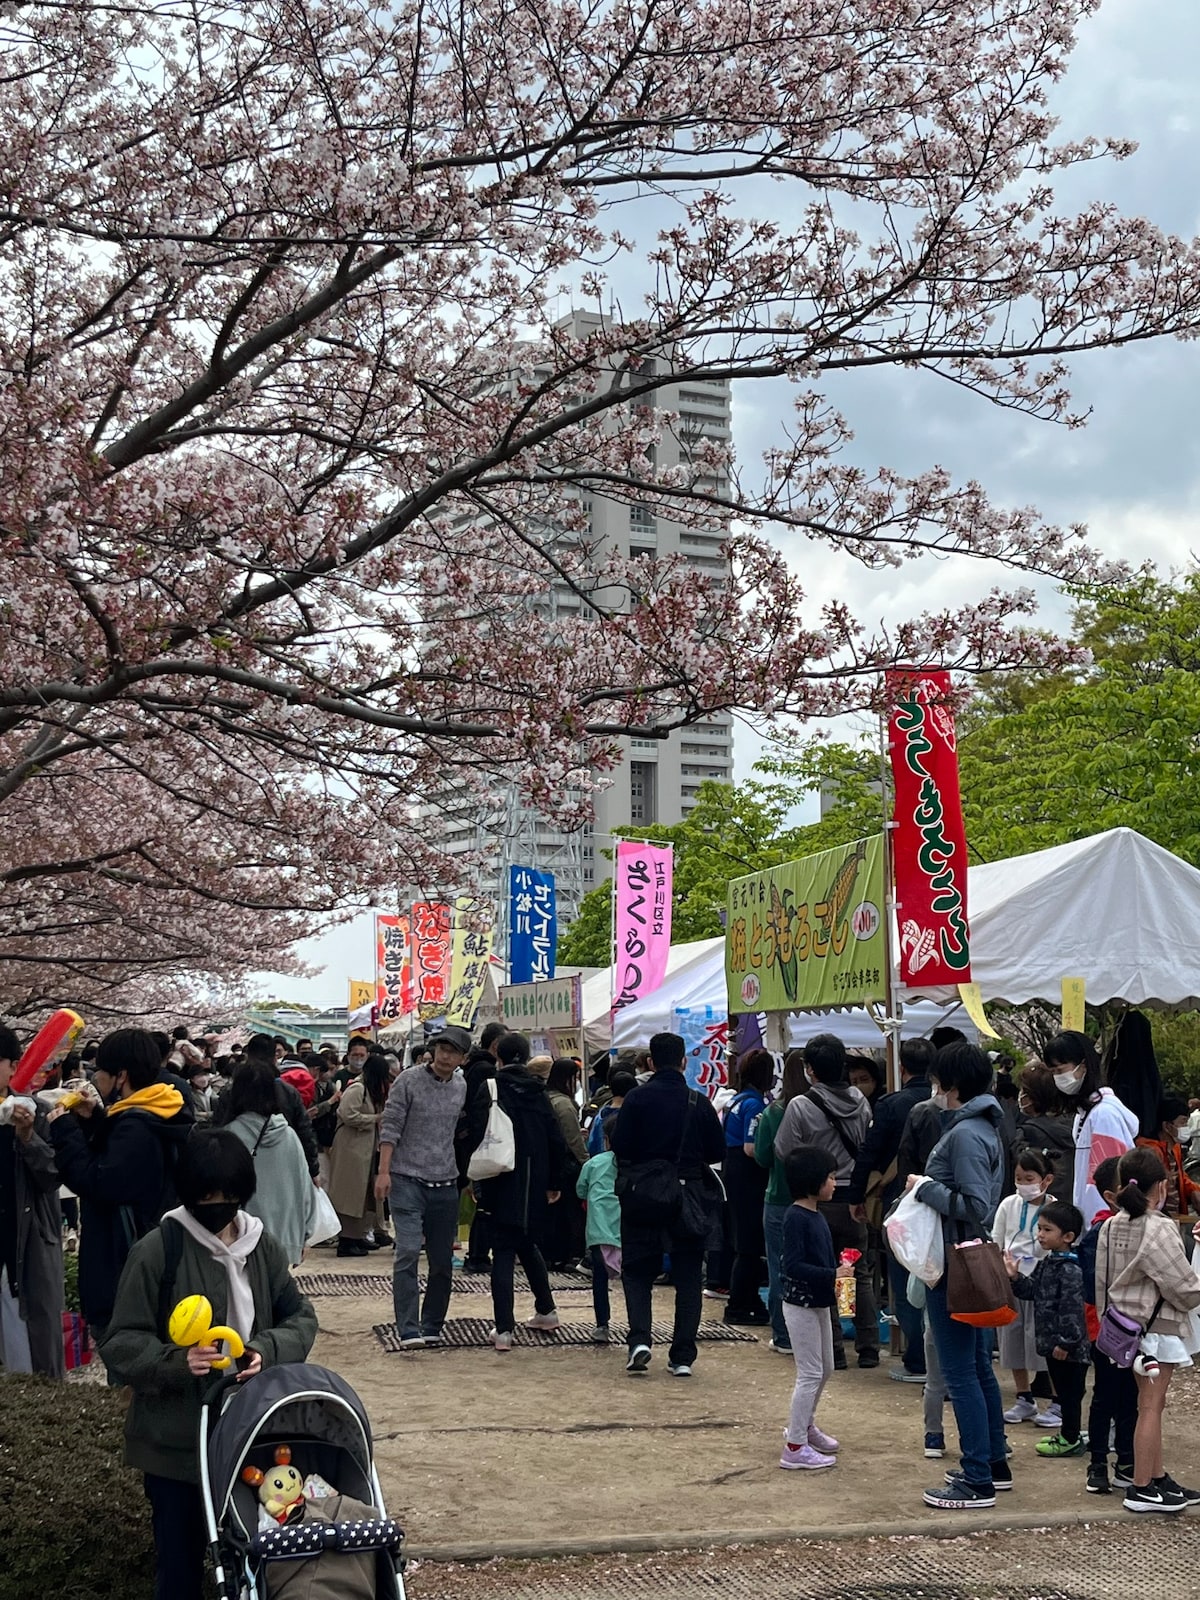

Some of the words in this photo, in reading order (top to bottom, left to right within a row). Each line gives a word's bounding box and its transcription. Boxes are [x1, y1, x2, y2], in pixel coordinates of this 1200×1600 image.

[652, 862, 665, 936] 江戸川区立
[732, 879, 765, 909] 宮元町会
[414, 906, 449, 1005] ねぎ焼
[731, 894, 848, 973] 焼とうもろこし
[381, 926, 405, 1019] 焼きそば
[937, 1499, 966, 1508] crocs
